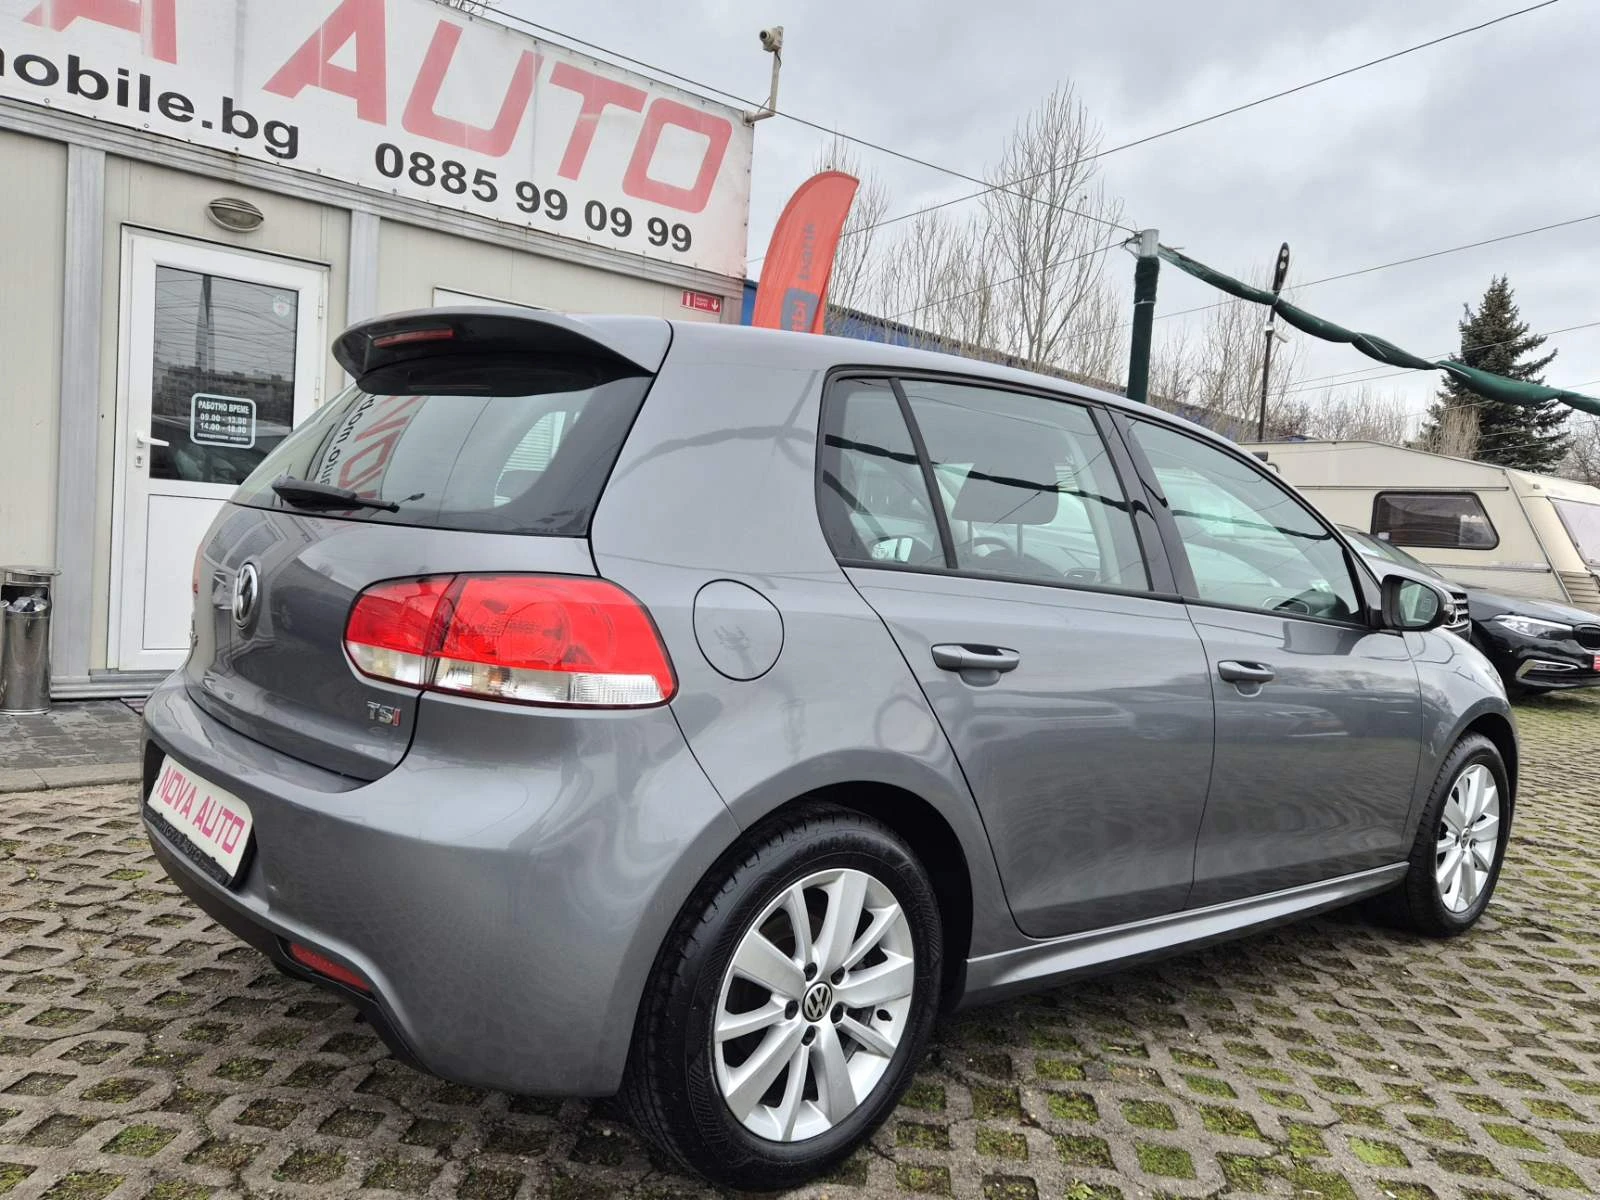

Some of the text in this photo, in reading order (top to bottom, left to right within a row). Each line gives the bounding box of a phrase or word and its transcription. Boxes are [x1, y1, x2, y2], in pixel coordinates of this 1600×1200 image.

[0, 46, 299, 160] obile.bg
[262, 0, 733, 213] AUTO
[375, 142, 692, 252] 0885 99 09 99
[198, 401, 249, 414] РАБОТНО ВРЕМЕ
[156, 765, 198, 820] NOVA
[192, 795, 246, 855] AUTO
